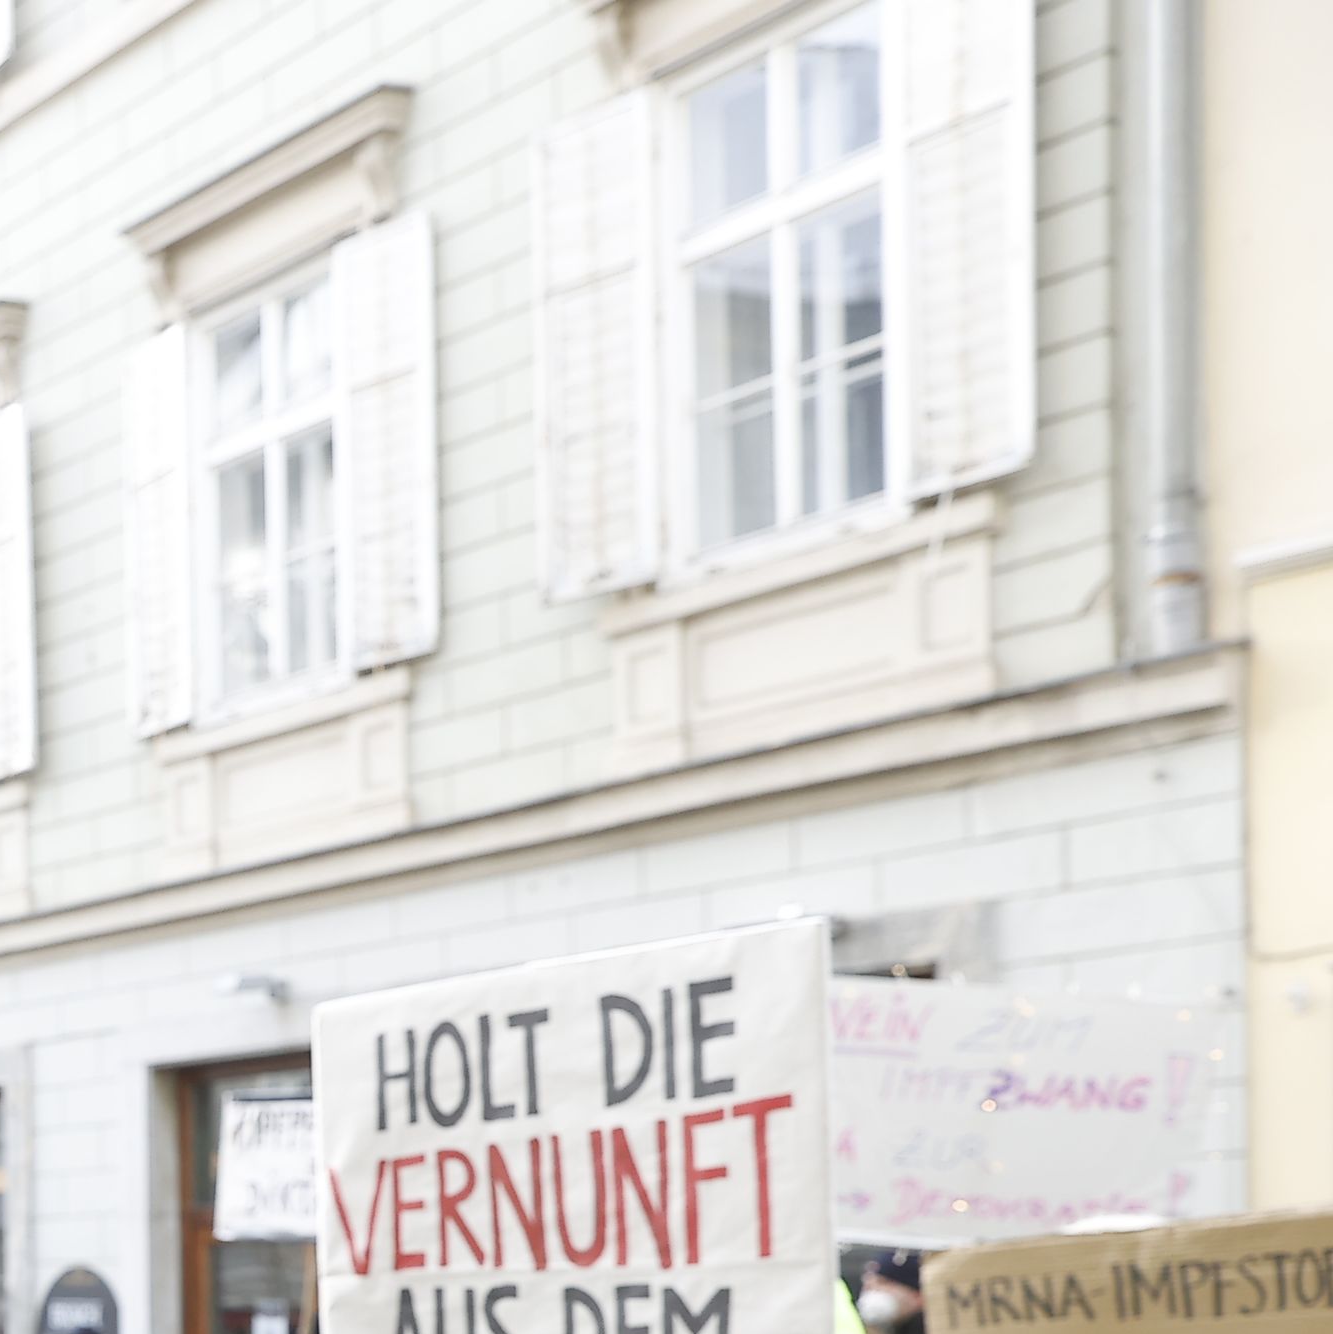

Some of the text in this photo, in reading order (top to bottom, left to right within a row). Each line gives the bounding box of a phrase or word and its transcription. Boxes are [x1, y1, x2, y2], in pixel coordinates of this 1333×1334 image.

[376, 976, 735, 1131] HOLT DIE
[329, 1092, 793, 1276] VERNUNFT
[946, 1246, 1333, 1330] MRNA-IMPFSTO
